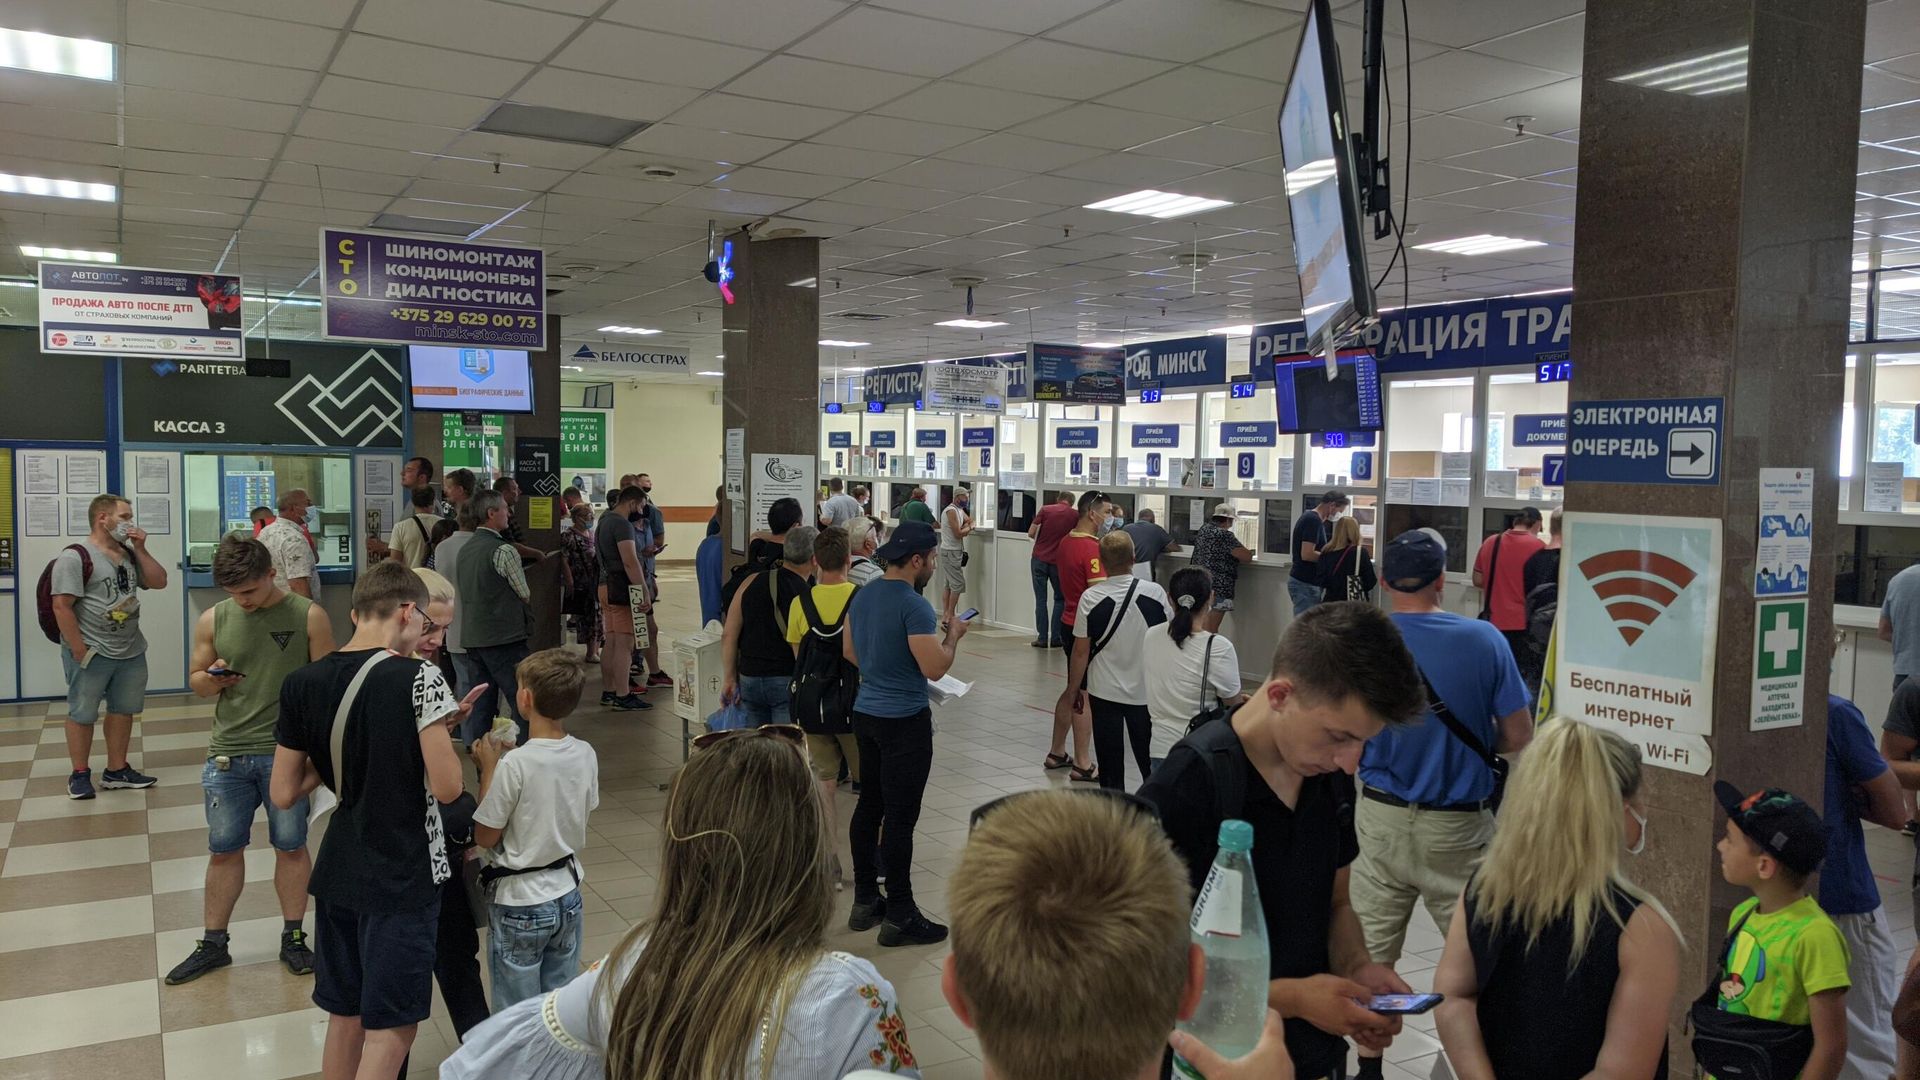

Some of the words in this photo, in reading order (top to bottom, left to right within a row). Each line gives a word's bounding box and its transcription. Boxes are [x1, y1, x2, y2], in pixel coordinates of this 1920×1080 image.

[385, 243, 536, 269] ШИНОМОНТАЖ
[385, 263, 536, 287] КОНДИЦИОНЕРЫ
[385, 282, 536, 306] ДИАГНОСТИКА
[52, 296, 104, 309] ПРОДАЖА
[107, 299, 134, 310] АВТО
[137, 301, 170, 312] ПОСЛЕ
[173, 303, 193, 314] ДТП
[85, 311, 129, 320] СТРАХОВЫХ
[131, 312, 173, 322] КОМПАНИЙ
[390, 308, 430, 323] +375
[433, 310, 453, 323] 29
[458, 311, 488, 326] 629
[492, 313, 513, 327] 00
[517, 315, 537, 329] 73
[415, 324, 537, 344] minsk-sto.com
[1255, 310, 1486, 366] РЕГРАЦИЯ
[601, 351, 687, 366] БЕЛГОССТРАХ
[1157, 349, 1208, 377] МИНСК
[1540, 363, 1570, 381] 517
[1142, 390, 1159, 402] 513
[1233, 384, 1252, 398] 514
[1572, 405, 1717, 425] ЭЛЕКТРОННАЯ
[153, 420, 211, 434] КАССА
[215, 421, 226, 434] 3
[1237, 425, 1258, 433] ПРИЁМ
[1228, 436, 1268, 444] ДОКУМЕНТОВ
[1572, 438, 1660, 459] ОЧЕРЕДЬ
[927, 455, 935, 468] 13
[981, 451, 991, 465] 12
[1071, 456, 1081, 472] 11
[1148, 457, 1160, 473] 10
[1241, 456, 1250, 475] 9
[1356, 456, 1366, 475] 8
[1550, 459, 1564, 482] 7
[1570, 672, 1693, 708] Бесплатный
[1584, 702, 1675, 731] интернет
[1646, 742, 1689, 765] Wi-Fi
